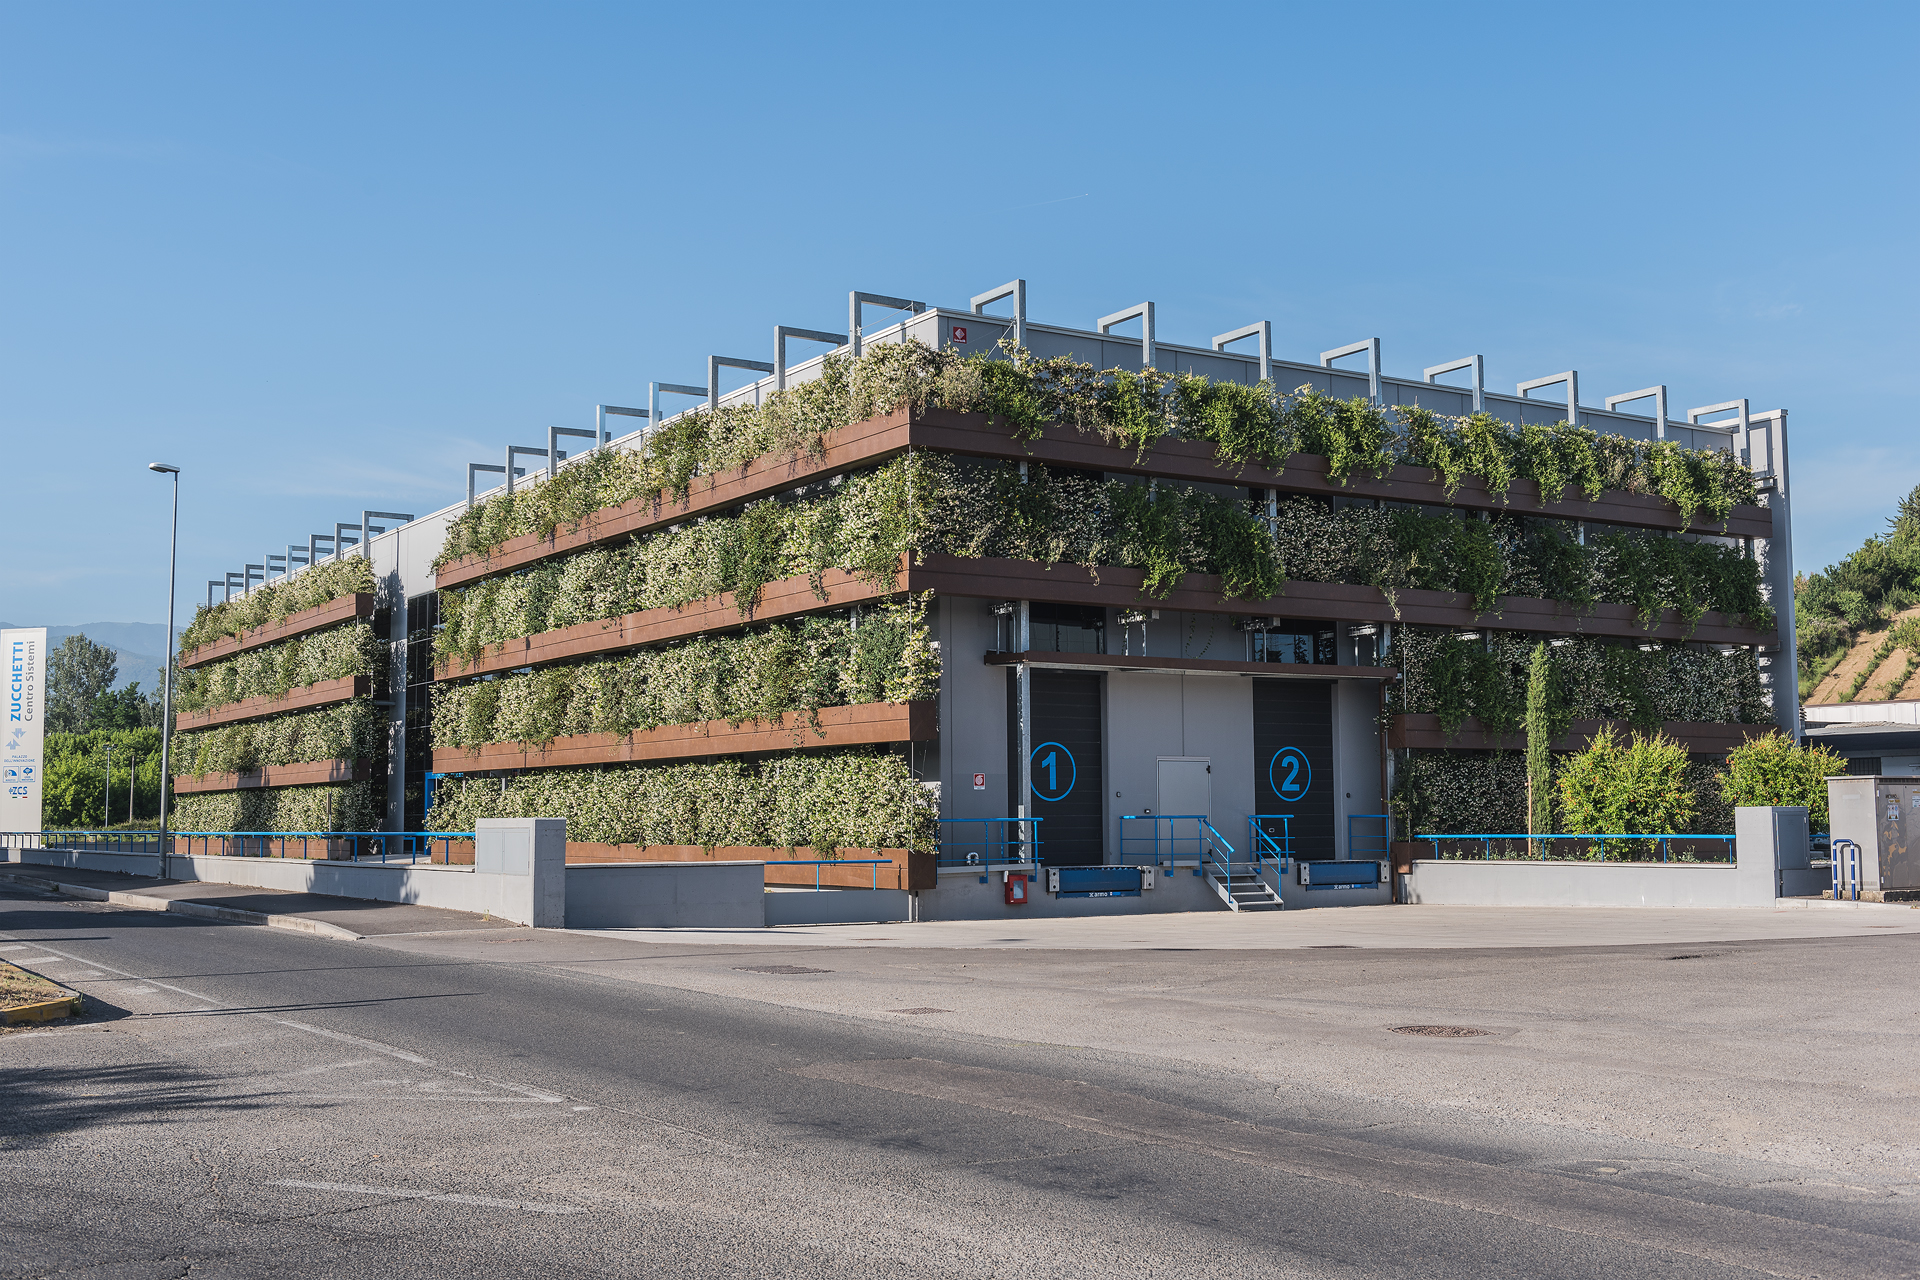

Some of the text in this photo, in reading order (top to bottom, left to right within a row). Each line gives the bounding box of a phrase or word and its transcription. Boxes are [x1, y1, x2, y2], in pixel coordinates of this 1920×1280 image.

[10, 641, 24, 722] ZUCCHETTI
[24, 640, 35, 722] Centro Sistemi
[1041, 751, 1057, 790] 1
[1281, 755, 1300, 791] 2
[12, 786, 28, 795] ZCS
